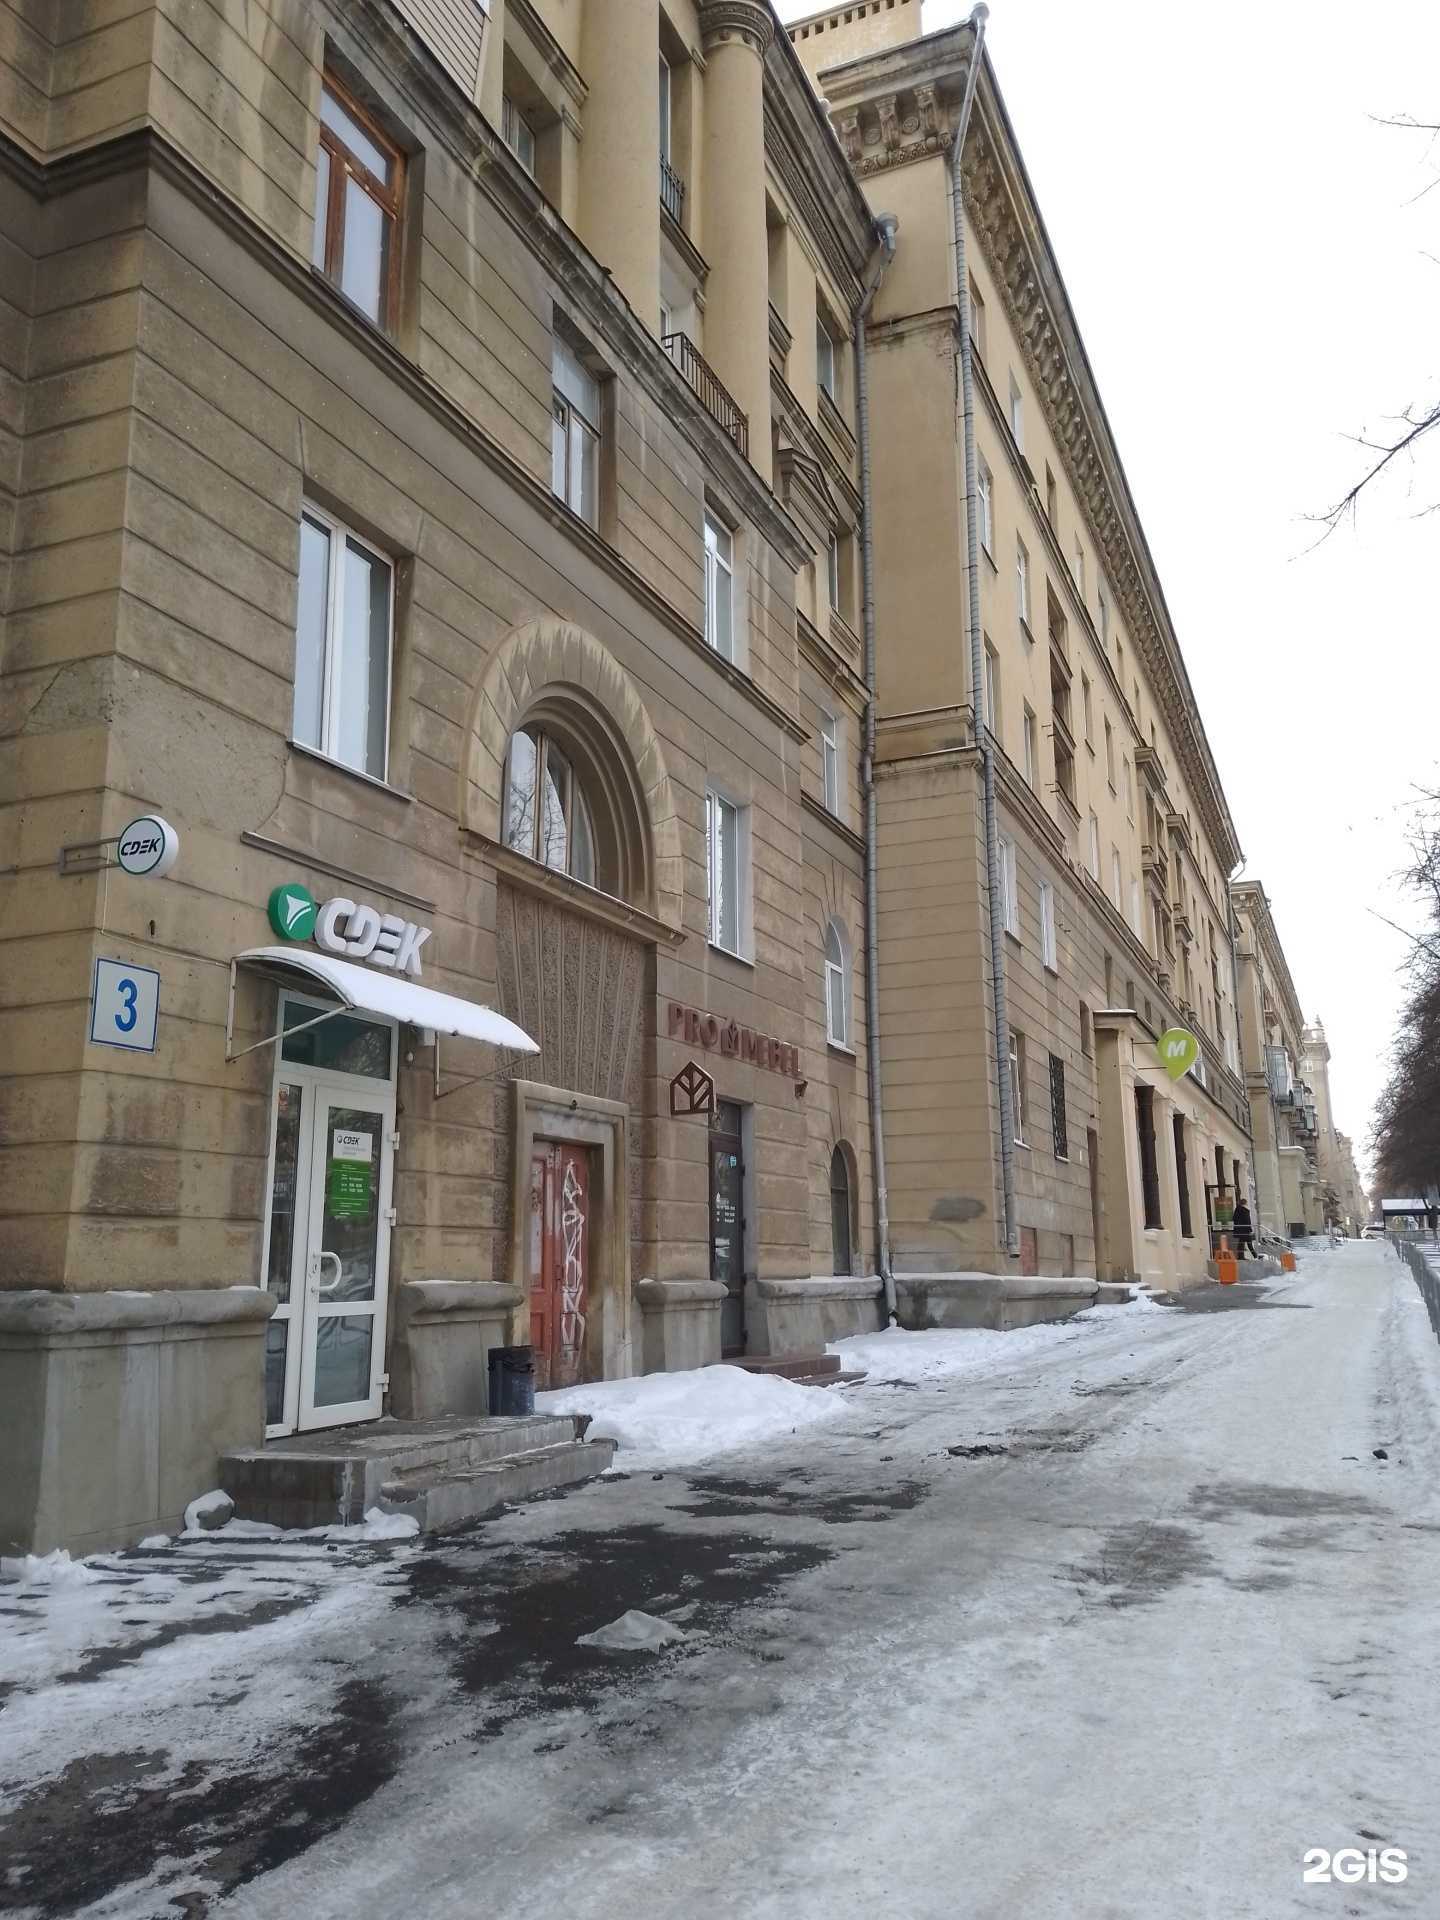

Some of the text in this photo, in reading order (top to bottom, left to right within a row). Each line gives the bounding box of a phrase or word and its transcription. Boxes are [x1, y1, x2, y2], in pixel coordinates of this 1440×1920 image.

[121, 837, 162, 856] CDEK
[315, 897, 432, 976] CDEK
[115, 979, 138, 1032] 3
[668, 1002, 803, 1076] PRO MEBEL
